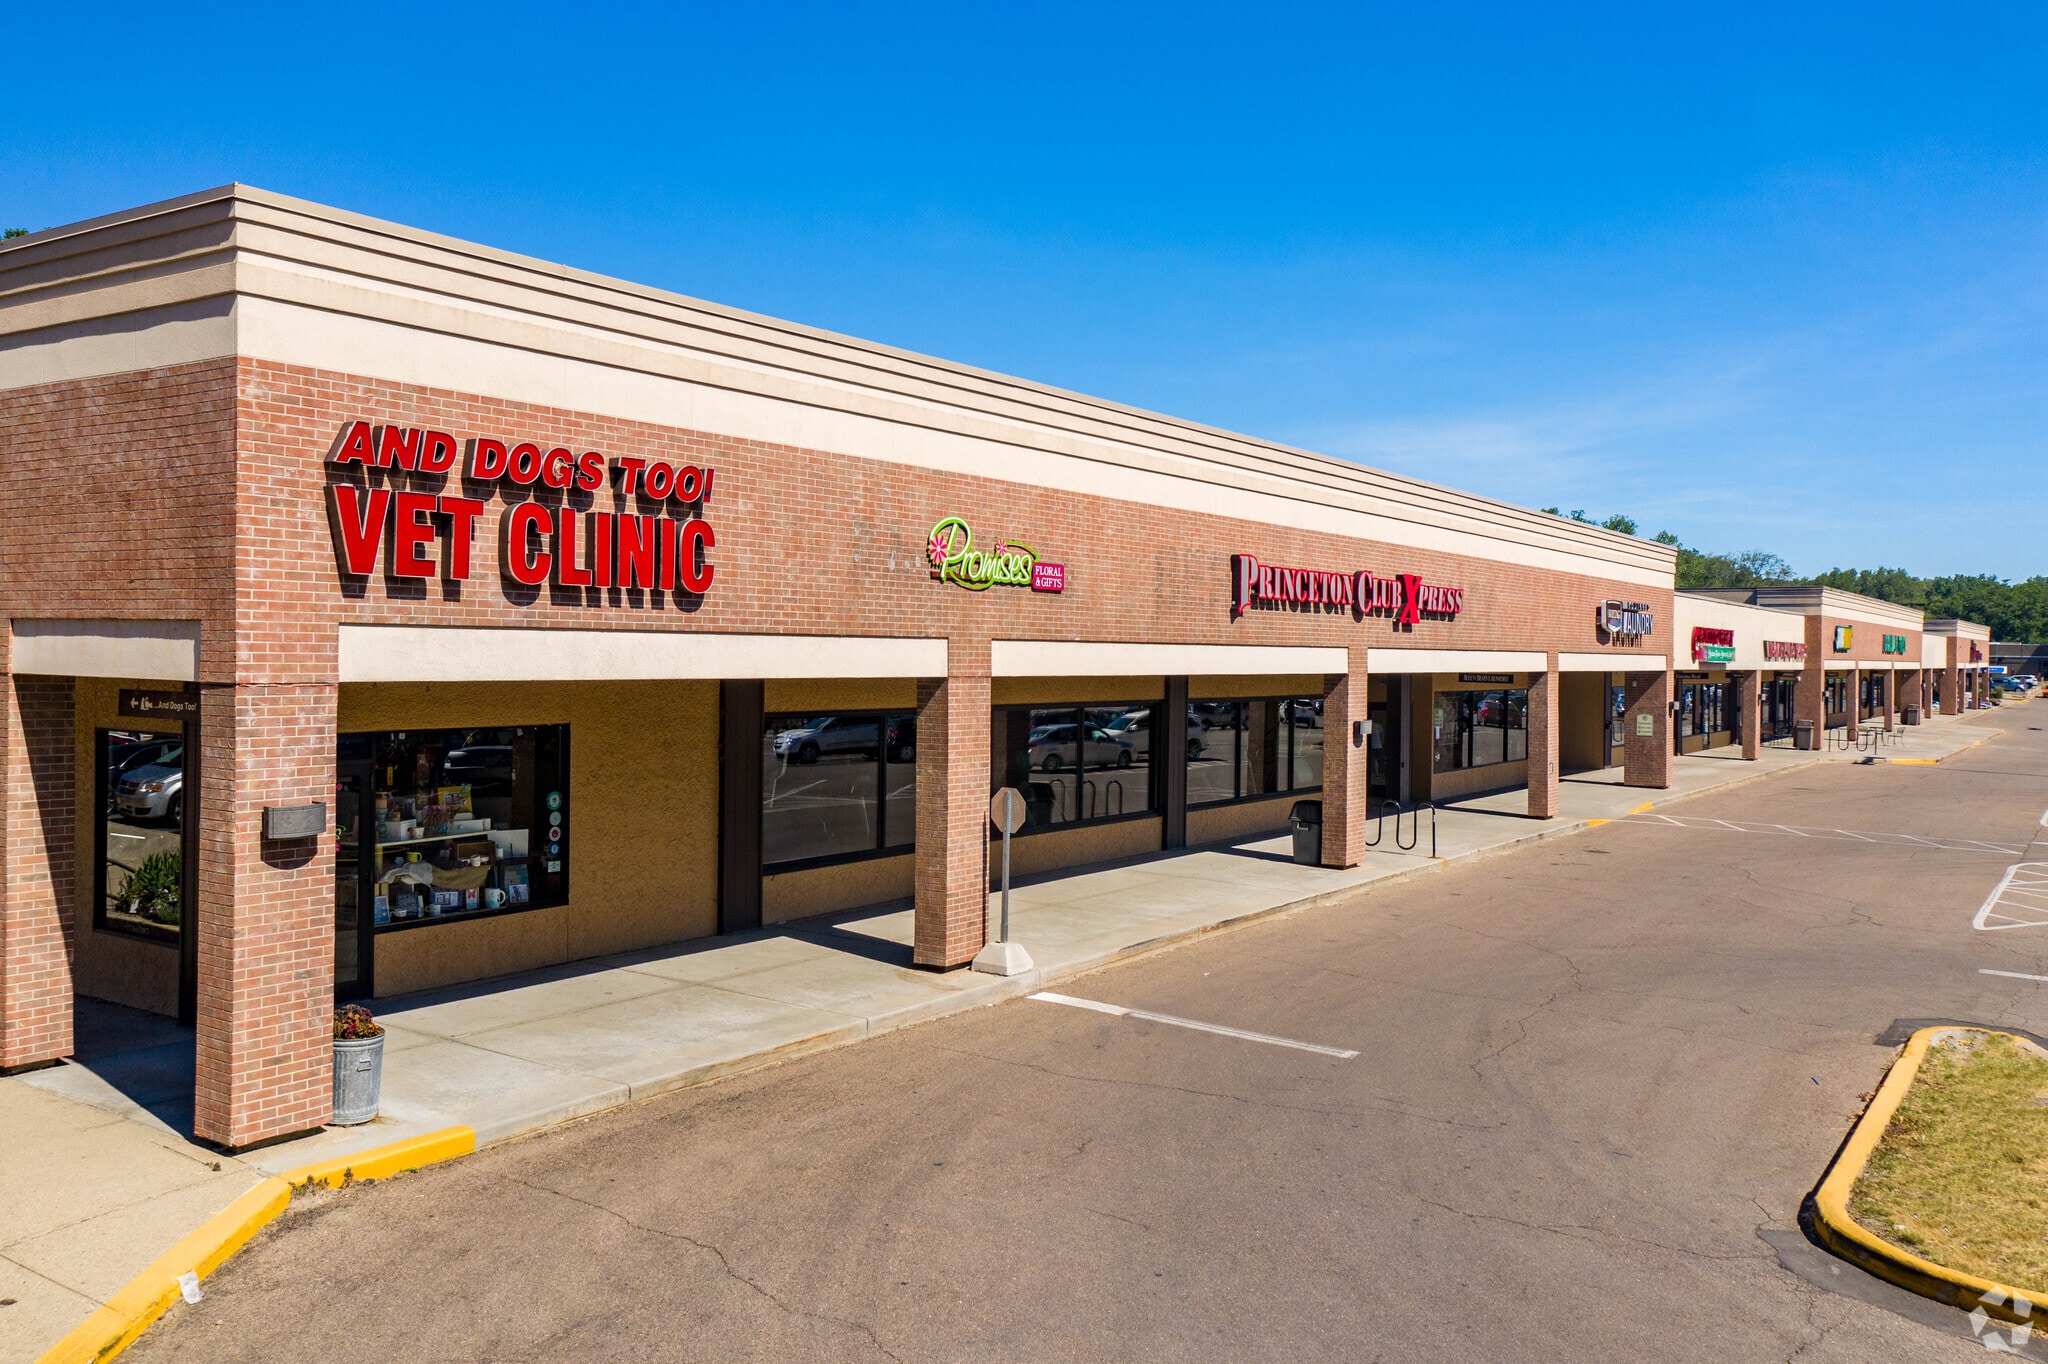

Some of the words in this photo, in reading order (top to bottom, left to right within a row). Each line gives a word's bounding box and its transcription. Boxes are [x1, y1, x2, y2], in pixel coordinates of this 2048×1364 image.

[328, 420, 458, 474] AND
[464, 437, 605, 492] DOGS
[612, 456, 715, 503] TOO!
[327, 484, 486, 580] VET
[503, 501, 716, 594] CLINIC
[928, 516, 1033, 585] Promises
[1035, 565, 1063, 577] FLORAL
[1035, 578, 1041, 587] &
[1041, 577, 1063, 588] GIFTS
[1621, 611, 1654, 635] LAUNDRY
[169, 701, 184, 712] Dogs
[184, 702, 197, 711] Too!
